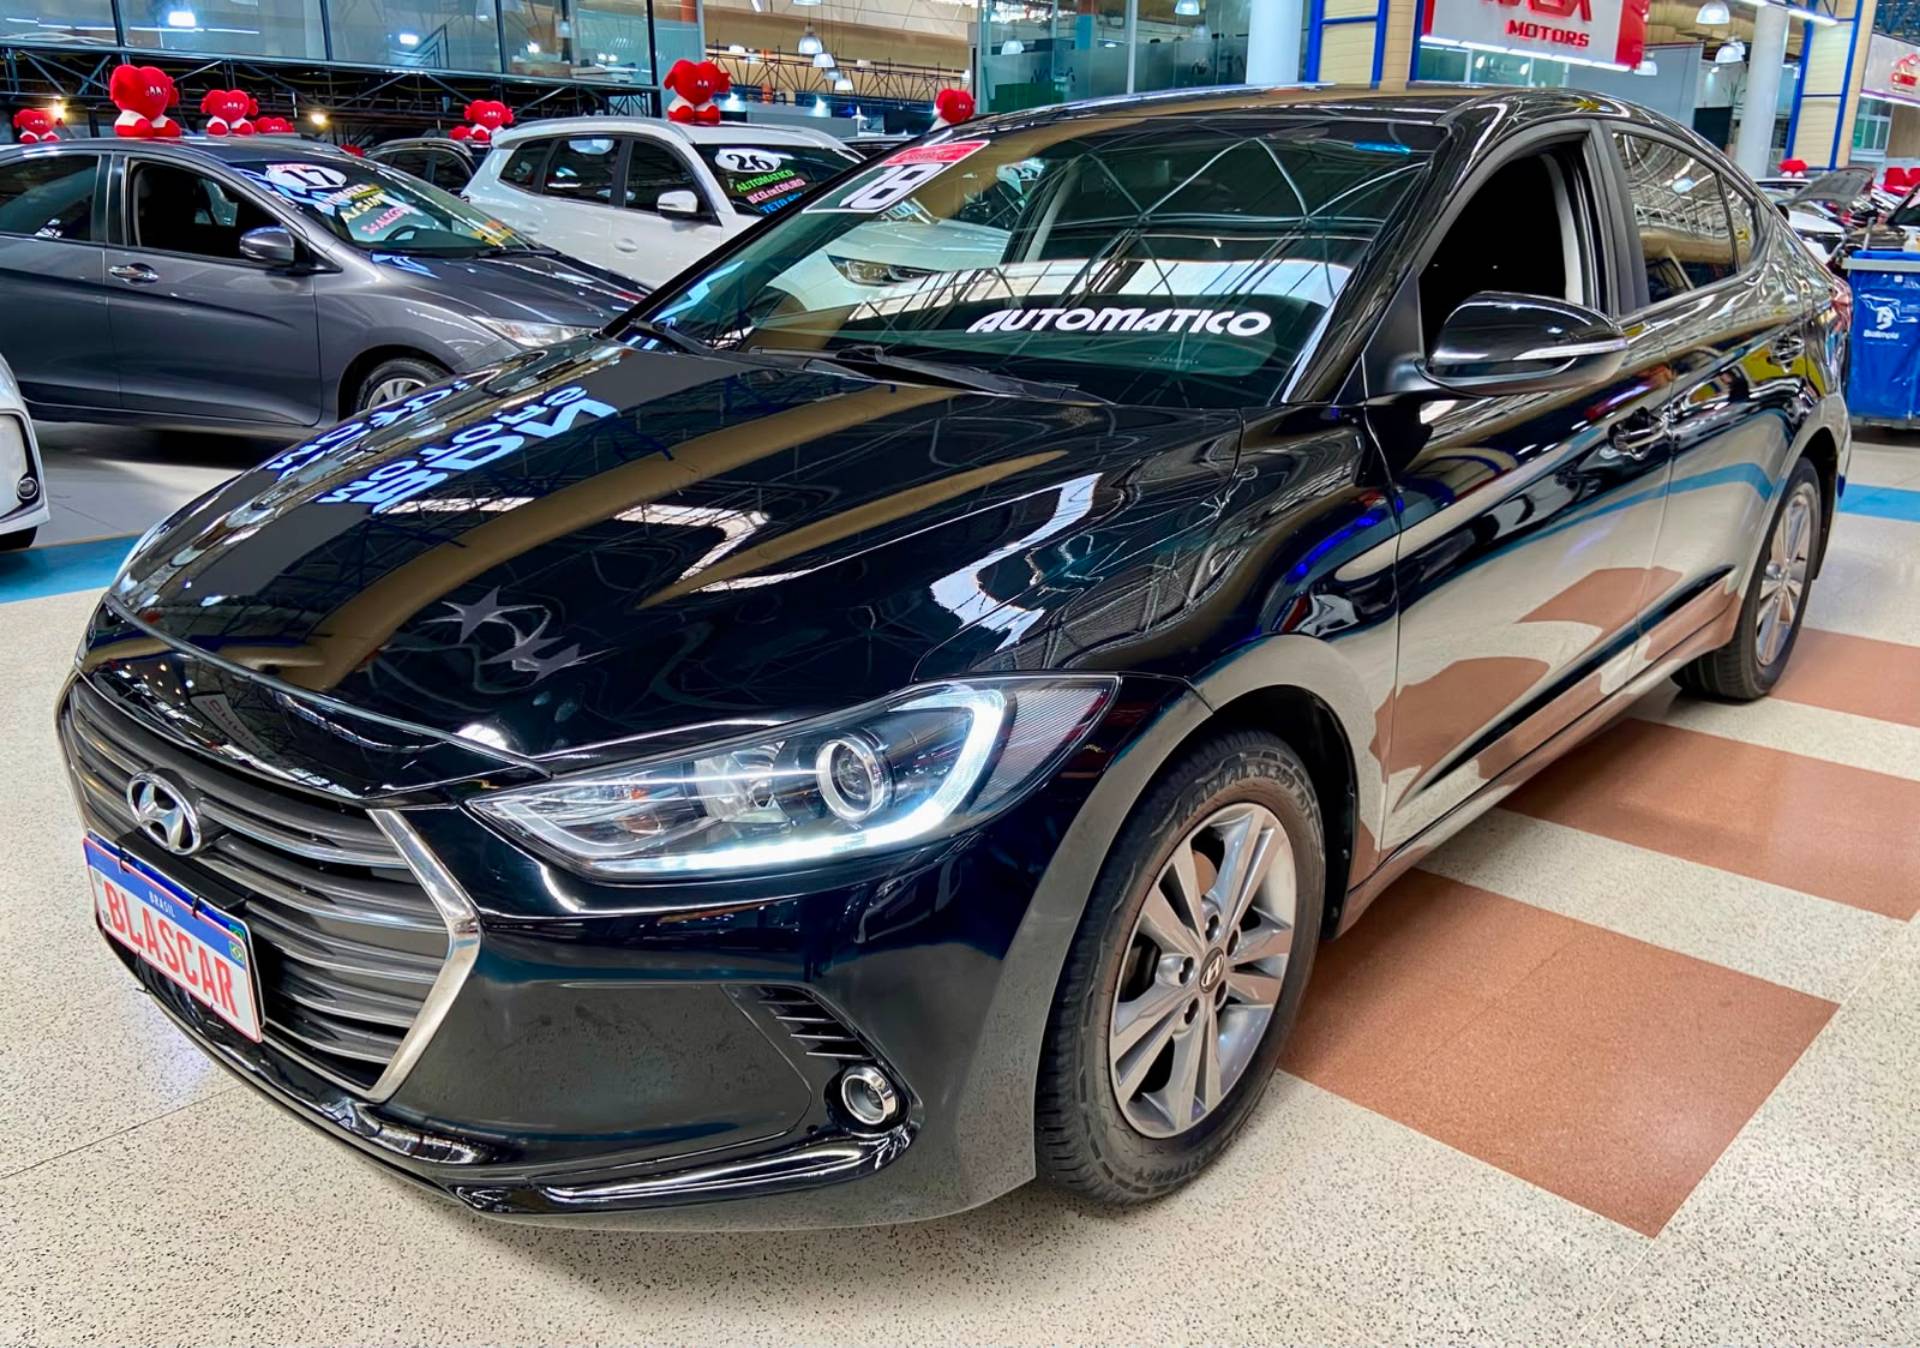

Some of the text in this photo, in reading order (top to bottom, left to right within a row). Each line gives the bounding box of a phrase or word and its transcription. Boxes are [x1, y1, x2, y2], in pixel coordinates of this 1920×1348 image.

[1506, 19, 1590, 47] MOTORS
[726, 153, 774, 171] 26
[282, 168, 339, 188] 17
[838, 163, 945, 209] 18
[965, 306, 1272, 337] AUTOMATICO
[148, 889, 176, 918] BRASIL
[104, 881, 239, 1018] BLASCAR
